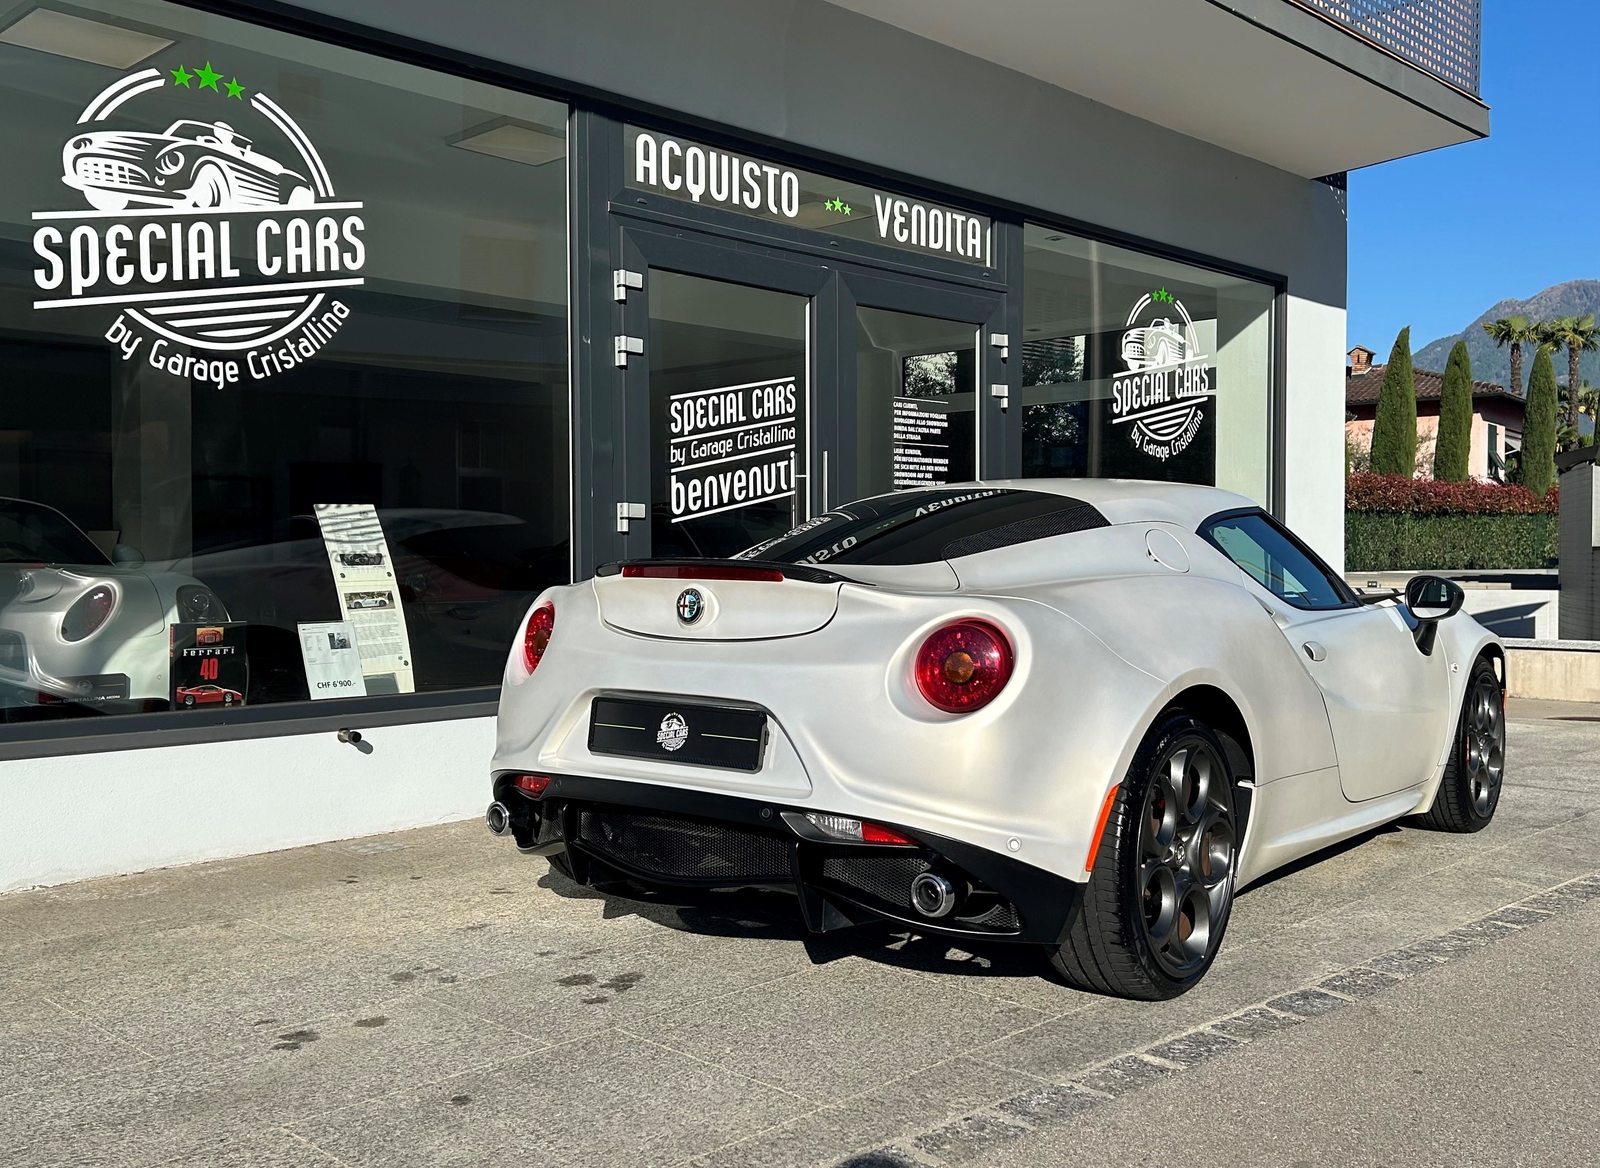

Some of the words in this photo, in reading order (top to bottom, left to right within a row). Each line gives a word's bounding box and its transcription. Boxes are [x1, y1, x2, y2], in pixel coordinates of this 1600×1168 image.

[635, 133, 799, 218] ACQUISTO
[873, 194, 981, 259] VENDITA
[33, 221, 240, 296] SPECIAL
[256, 215, 366, 276] CARS
[104, 314, 143, 361] by
[149, 339, 239, 390] Garage
[246, 300, 351, 380] Cristallina
[670, 391, 747, 435] SPECIAL
[752, 384, 796, 419] CARS
[1112, 371, 1171, 416] SPECIAL
[1175, 363, 1209, 399] CARS
[670, 445, 686, 466] by
[690, 439, 733, 459] Garage
[737, 425, 796, 450] Cristallina
[1131, 424, 1142, 448] by
[1143, 436, 1170, 462] Garage
[1171, 410, 1204, 455] Cristallina
[670, 451, 796, 515] benvenuti
[183, 646, 236, 657] Ferrari
[200, 657, 219, 680] 40
[317, 681, 331, 689] CHF
